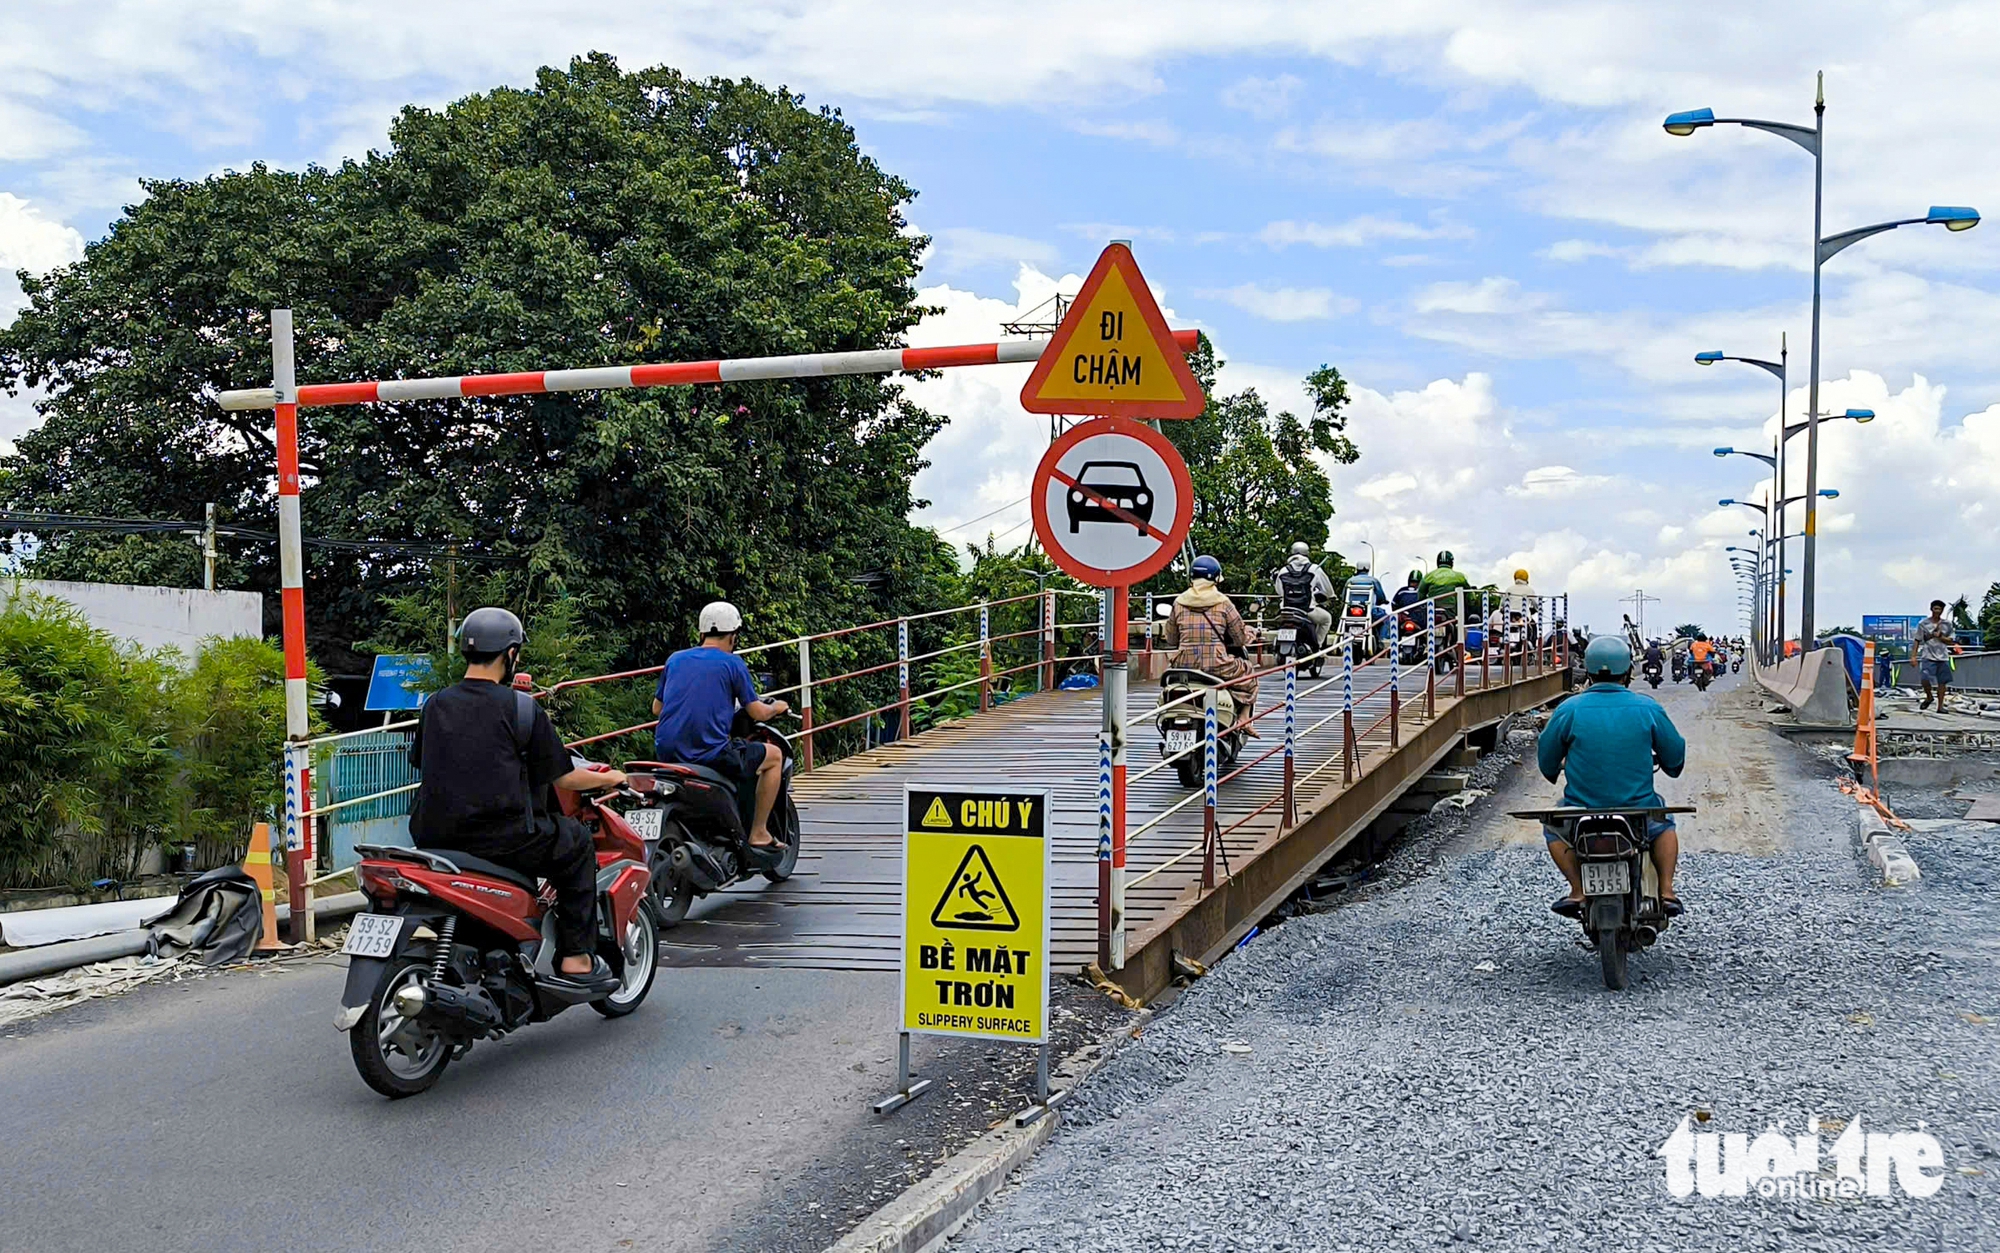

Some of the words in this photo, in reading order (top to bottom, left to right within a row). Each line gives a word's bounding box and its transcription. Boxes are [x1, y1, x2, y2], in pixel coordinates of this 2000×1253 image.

[1100, 311, 1123, 341] ĐI
[1073, 348, 1141, 390] CHẬM
[630, 812, 656, 825] 59-S2
[961, 797, 1010, 829] CHÚ
[1017, 798, 1033, 829] Ý
[1589, 879, 1622, 893] 5355
[358, 917, 395, 936] 59-S2
[346, 934, 392, 954] 417.59
[920, 938, 955, 970] BỀ
[966, 945, 1030, 978] MẶT
[935, 980, 1015, 1009] TRƠN
[918, 1012, 973, 1028] SLIPPERY
[977, 1016, 1031, 1033] SURFACE
